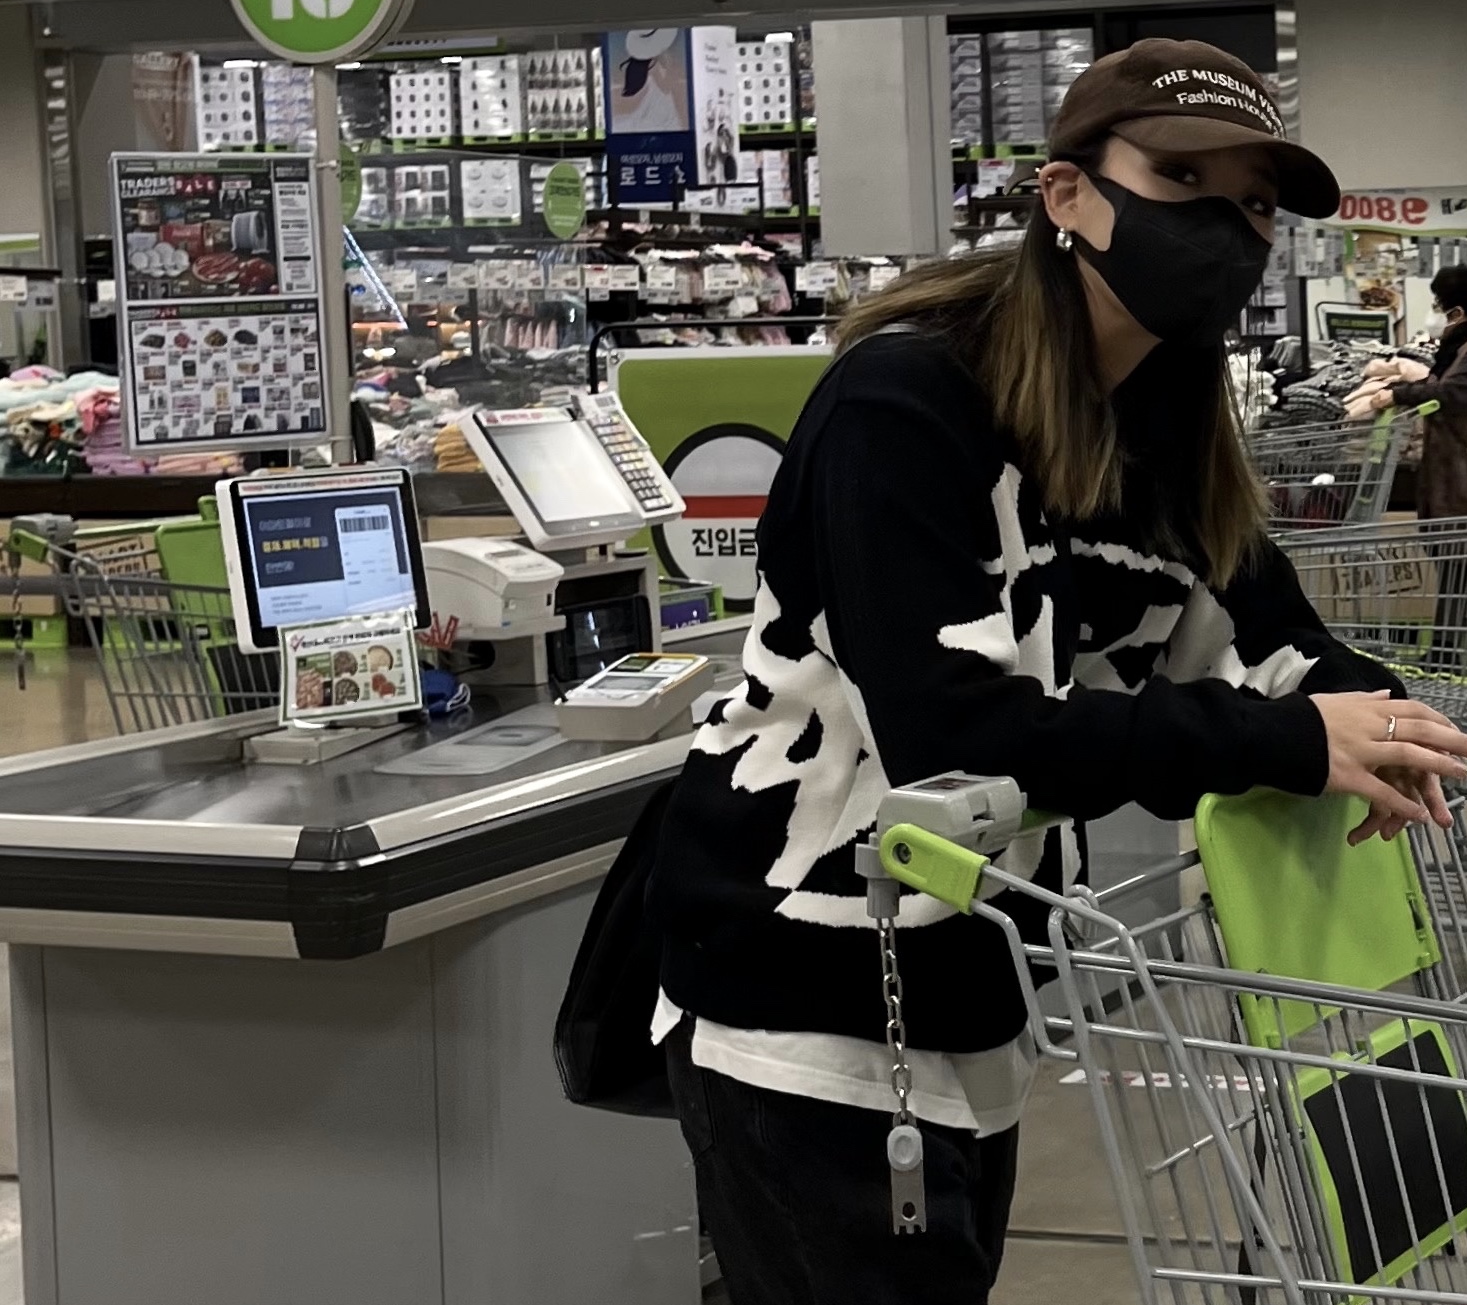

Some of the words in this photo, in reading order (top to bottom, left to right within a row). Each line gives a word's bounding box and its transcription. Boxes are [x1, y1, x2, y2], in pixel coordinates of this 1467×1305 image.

[1152, 69, 1189, 88] THE
[1191, 69, 1257, 101] MUSEUM
[1176, 89, 1236, 105] Fashion
[120, 176, 176, 189] TRADERS
